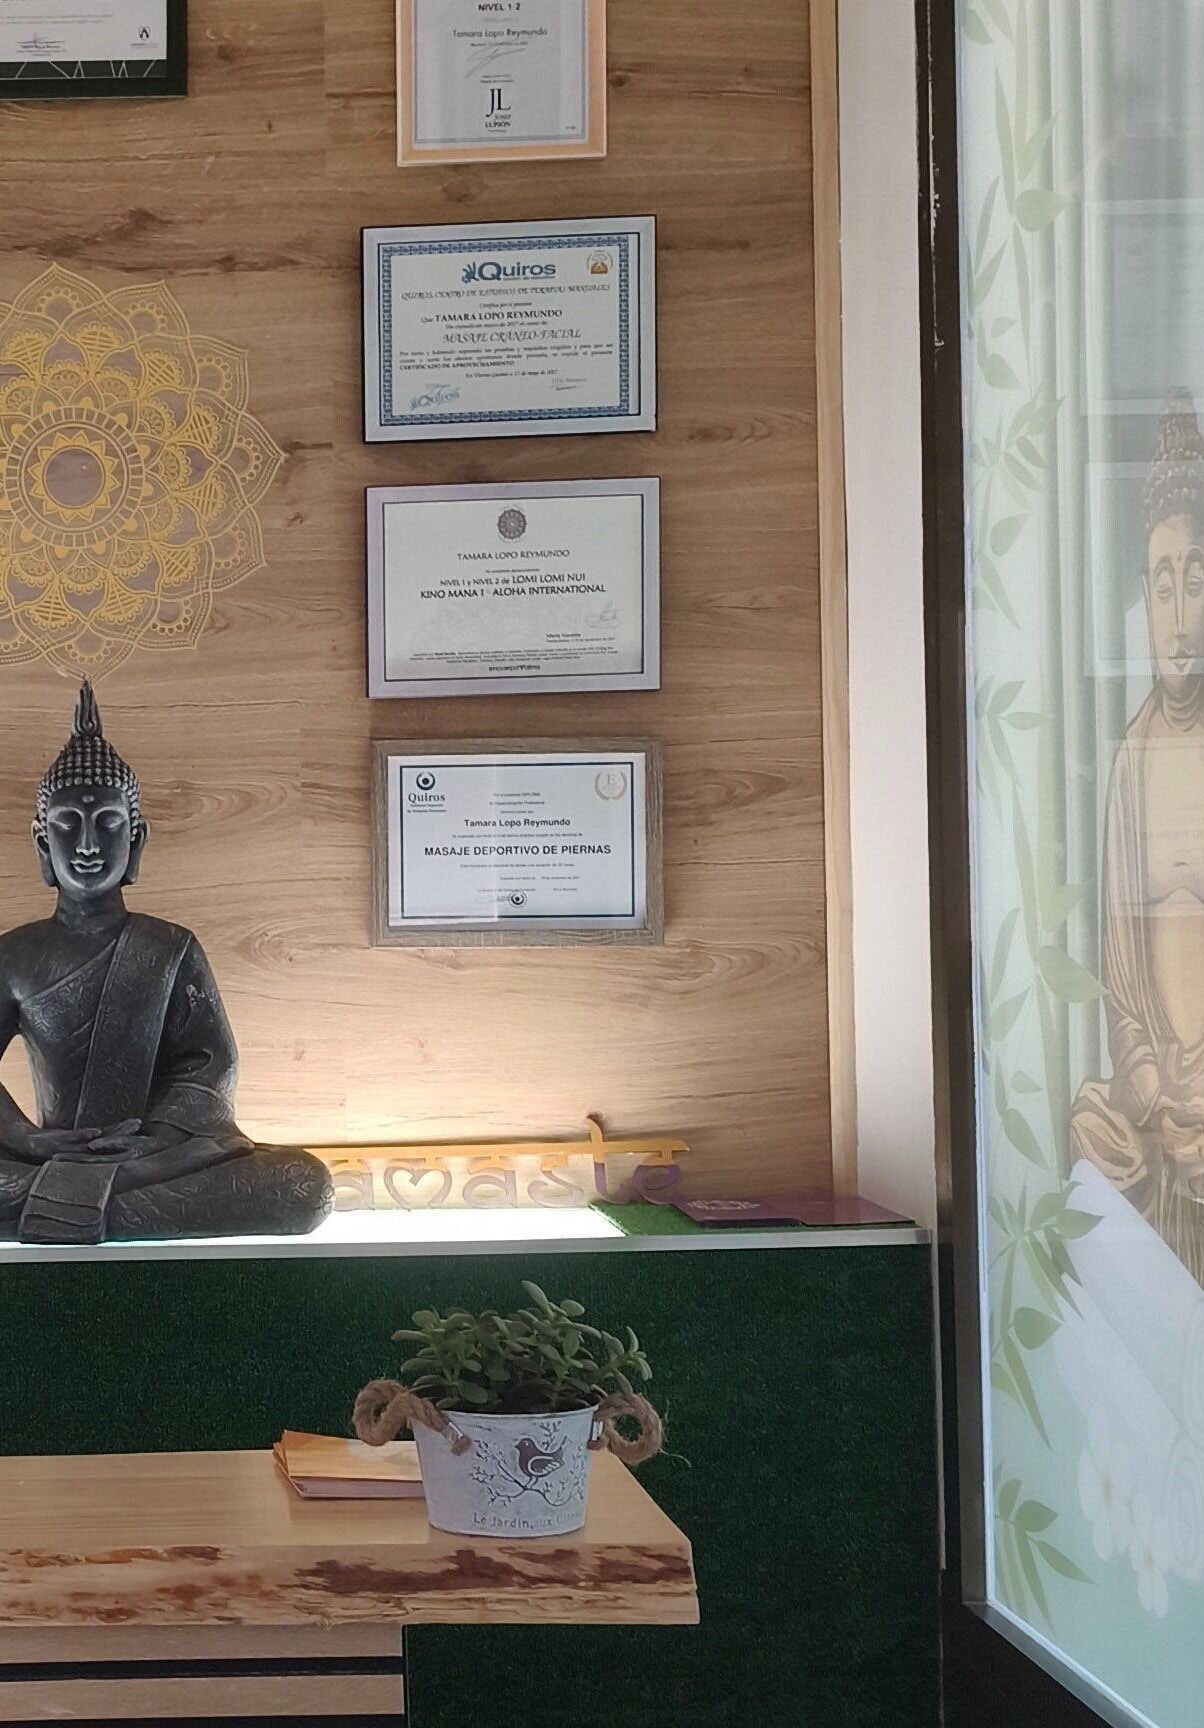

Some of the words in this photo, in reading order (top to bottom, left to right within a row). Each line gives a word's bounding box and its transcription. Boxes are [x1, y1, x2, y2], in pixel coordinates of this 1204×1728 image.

[478, 3, 504, 11] NIVEL
[452, 29, 482, 39] Tamara
[506, 26, 548, 39] Reymundo
[485, 88, 512, 118] JL
[477, 261, 556, 282] Quiros
[435, 313, 477, 322] TAMARA
[478, 311, 505, 320] LOPO
[506, 309, 563, 319] REYMUNDO
[457, 551, 493, 561] TAMARA
[495, 550, 519, 560] LOPO
[520, 548, 571, 559] REYMUNDO
[439, 578, 461, 587] NIVEL
[472, 577, 493, 586] NIVEL
[511, 574, 539, 585] LOMI
[539, 573, 566, 584] LOMI
[567, 572, 586, 582] NUI
[420, 588, 446, 600] KINO
[447, 587, 479, 599] MANA
[492, 585, 527, 597] ALOHA
[528, 583, 606, 596] INTERNATIONAL
[408, 792, 446, 804] Quiros
[464, 818, 497, 828] Tamara
[498, 818, 522, 829] Lopo
[523, 817, 571, 829] Reymundo
[424, 846, 471, 857] MASAJE
[473, 845, 540, 856] DEPORTIVO
[542, 845, 558, 856] DE
[560, 844, 612, 855] PIERNAS
